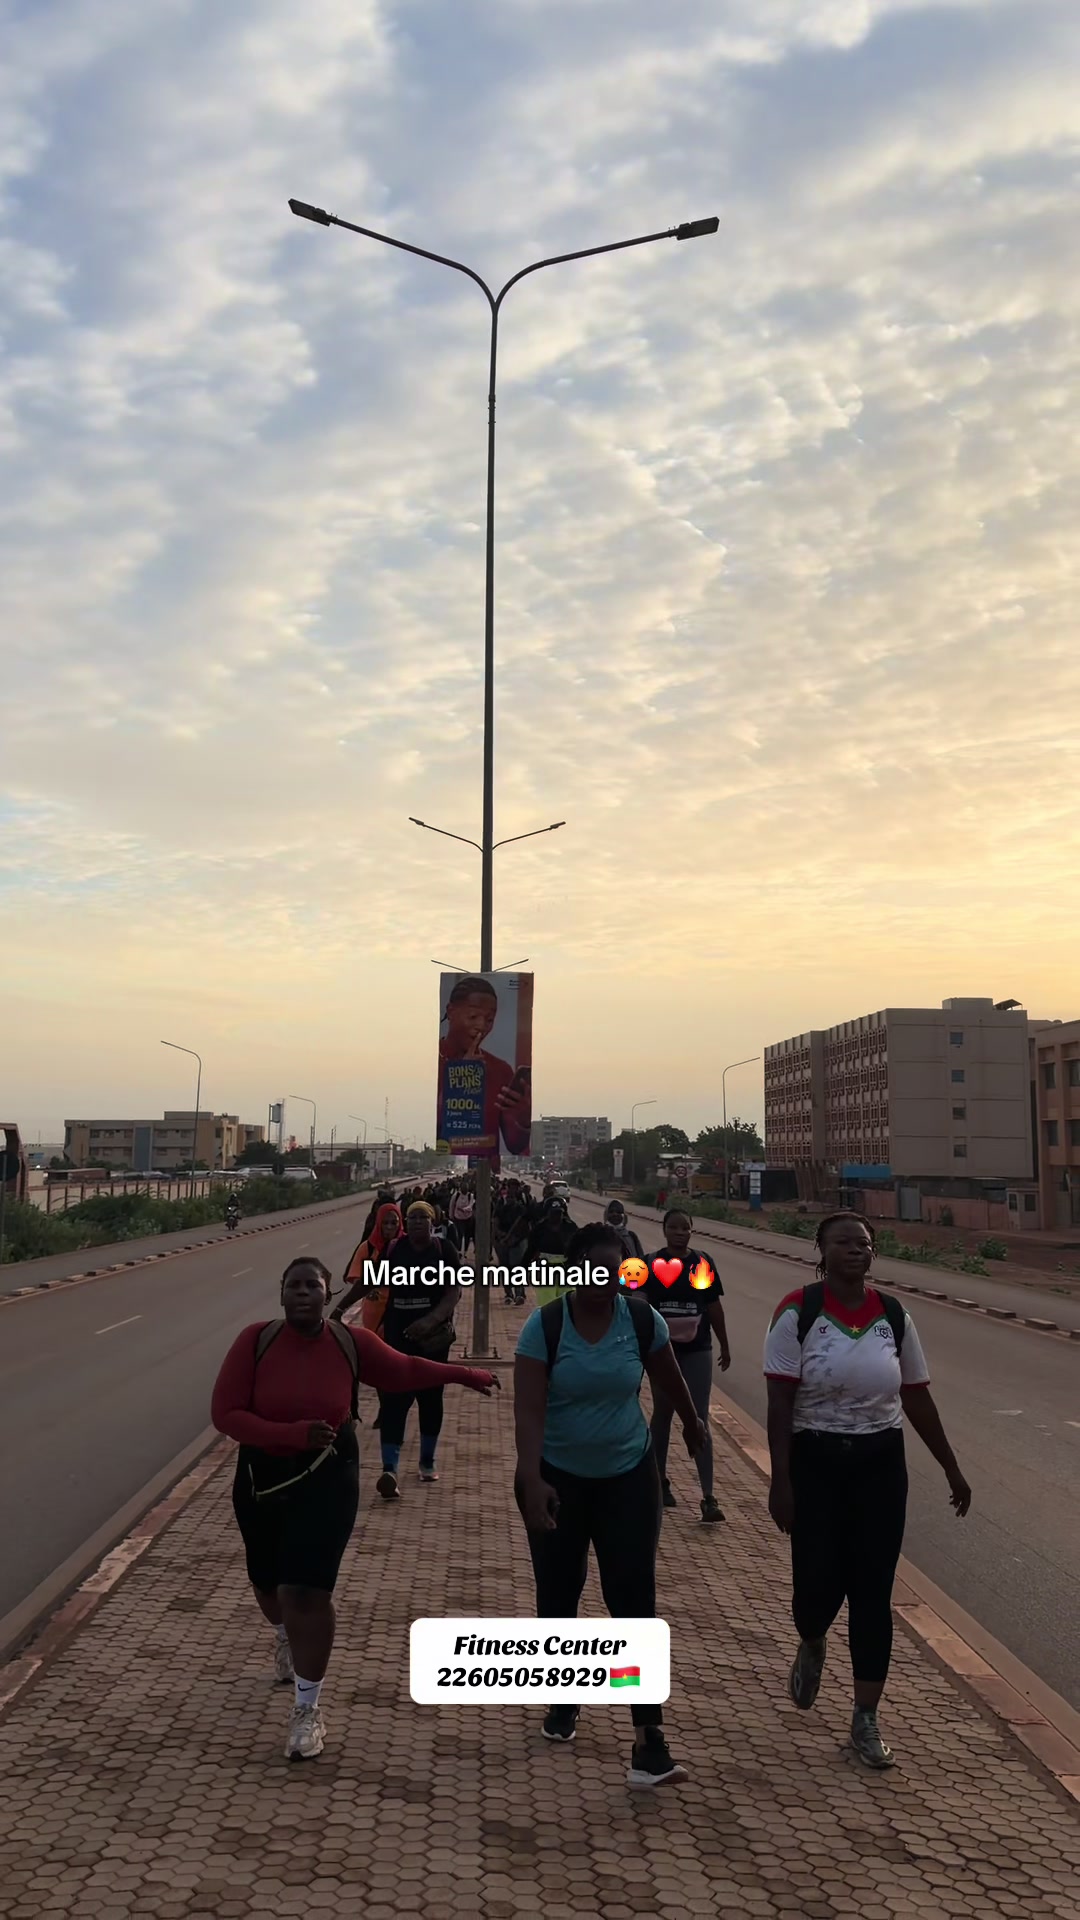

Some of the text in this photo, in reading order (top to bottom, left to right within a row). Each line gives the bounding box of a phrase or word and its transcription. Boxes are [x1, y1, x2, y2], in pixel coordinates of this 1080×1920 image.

[448, 1064, 474, 1078] BONS
[449, 1075, 481, 1088] PLANS
[446, 1098, 473, 1110] 1000
[452, 1120, 467, 1128] 525
